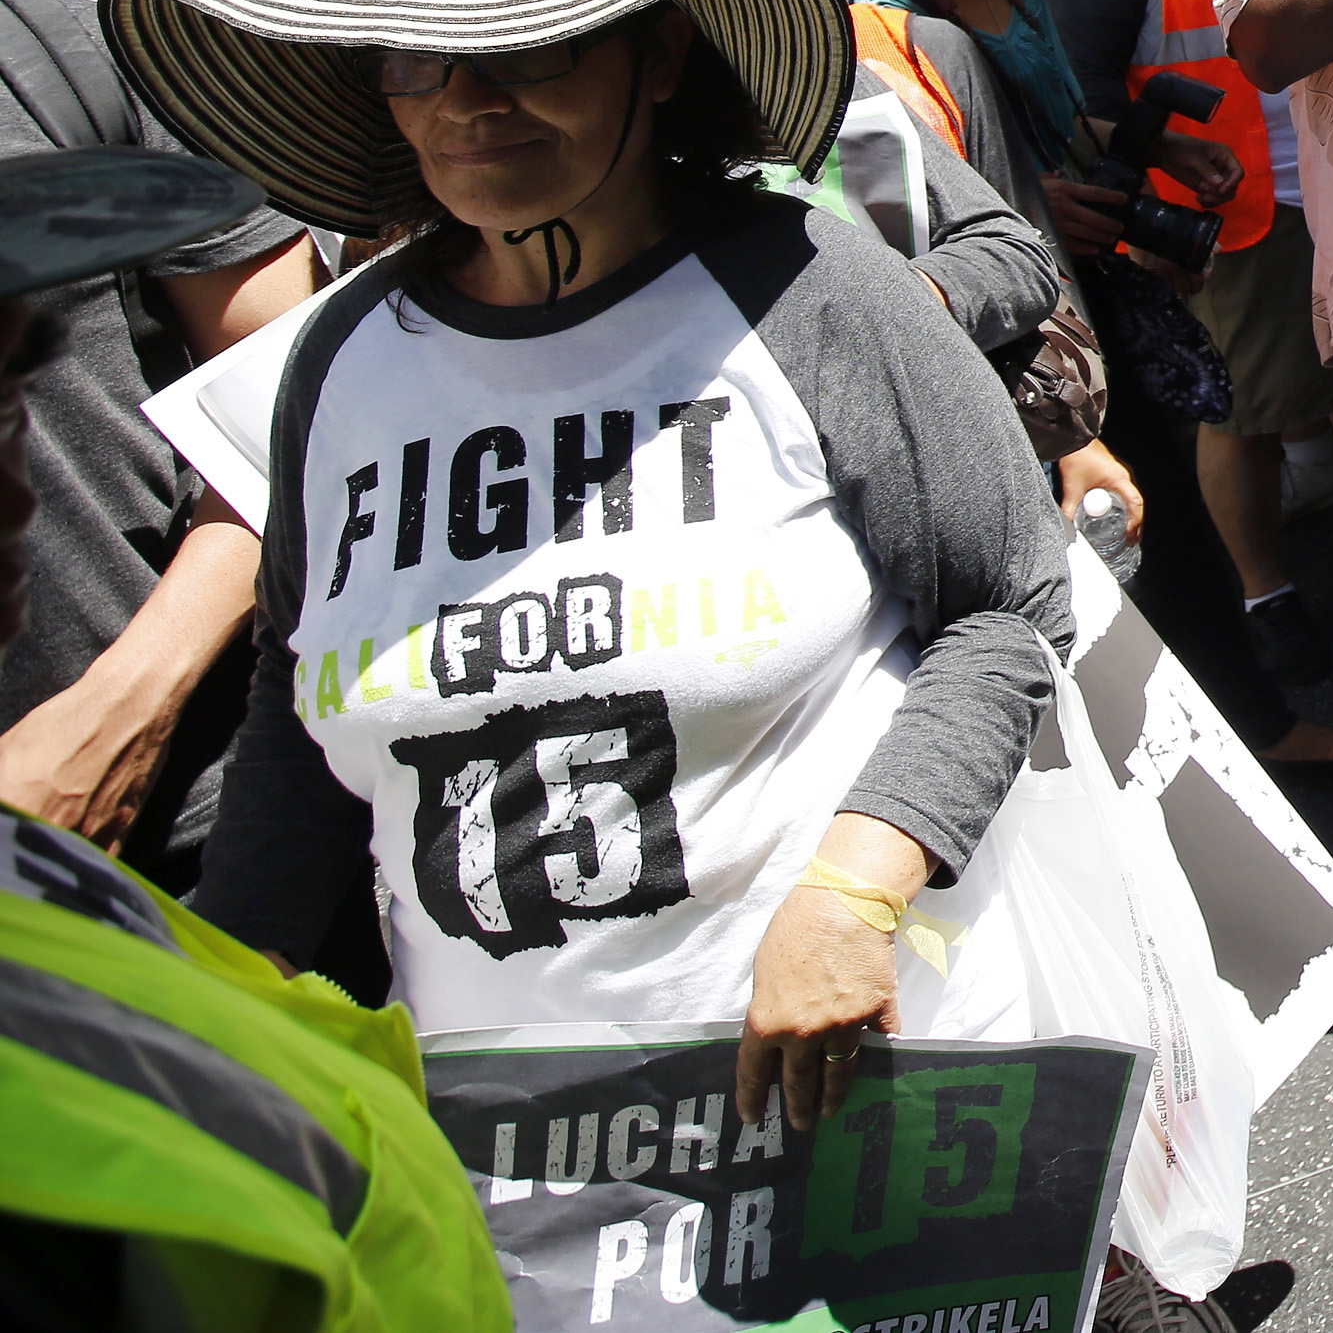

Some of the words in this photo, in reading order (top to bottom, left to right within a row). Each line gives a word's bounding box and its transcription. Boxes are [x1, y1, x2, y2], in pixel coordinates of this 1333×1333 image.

[327, 396, 731, 601] FIGHT
[438, 722, 646, 936] 15
[1139, 952, 1150, 984] STORE
[1153, 1068, 1165, 1083] TO
[489, 1083, 788, 1206] LUCHA
[844, 1083, 1004, 1236] 15
[589, 1185, 777, 1325] POR
